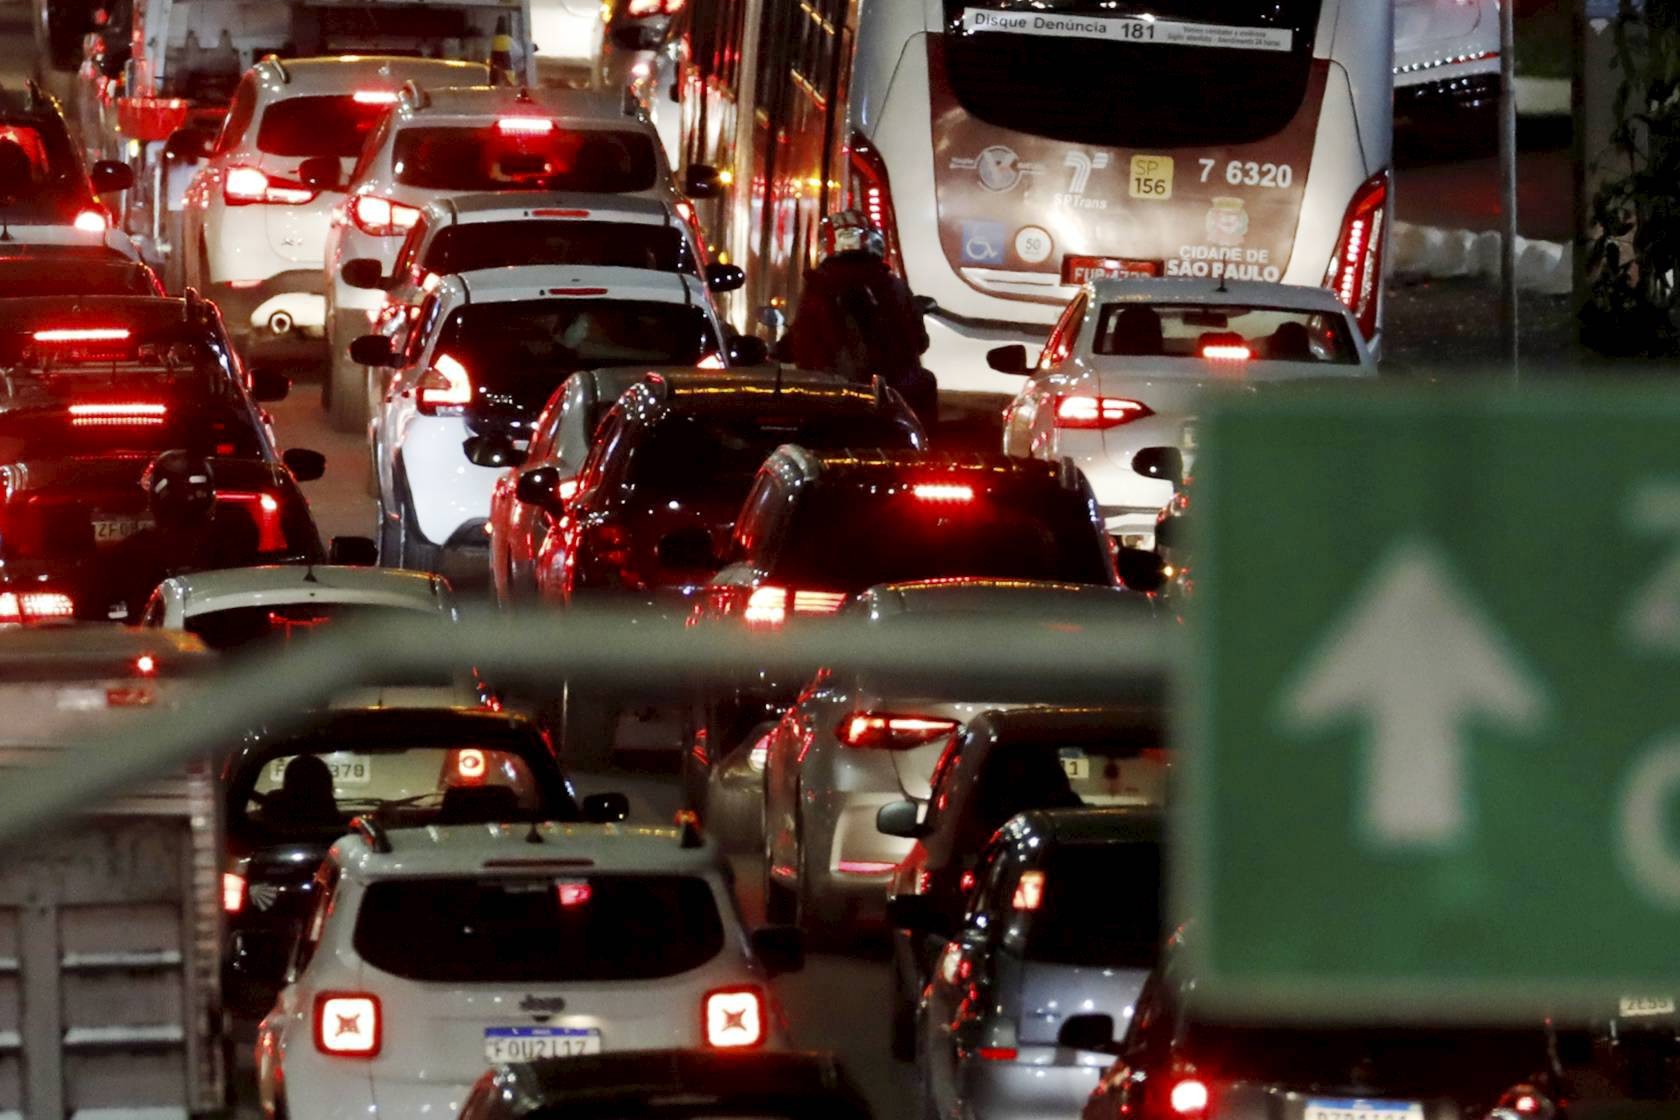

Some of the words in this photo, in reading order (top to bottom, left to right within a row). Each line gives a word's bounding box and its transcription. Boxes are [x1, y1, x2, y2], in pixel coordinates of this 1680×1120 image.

[975, 12, 1027, 30] Disque
[1034, 16, 1107, 34] Denúncia
[1121, 22, 1155, 40] 181
[1135, 159, 1160, 176] SP
[1198, 158, 1216, 183] 7
[1225, 160, 1293, 189] 6320
[1134, 177, 1166, 196] 156
[1053, 192, 1108, 210] SPTrans
[1025, 238, 1041, 251] 50
[1179, 245, 1242, 262] CIDADE
[1246, 249, 1270, 264] DE
[1167, 256, 1210, 277] SÃO
[1212, 262, 1281, 283] PAULO
